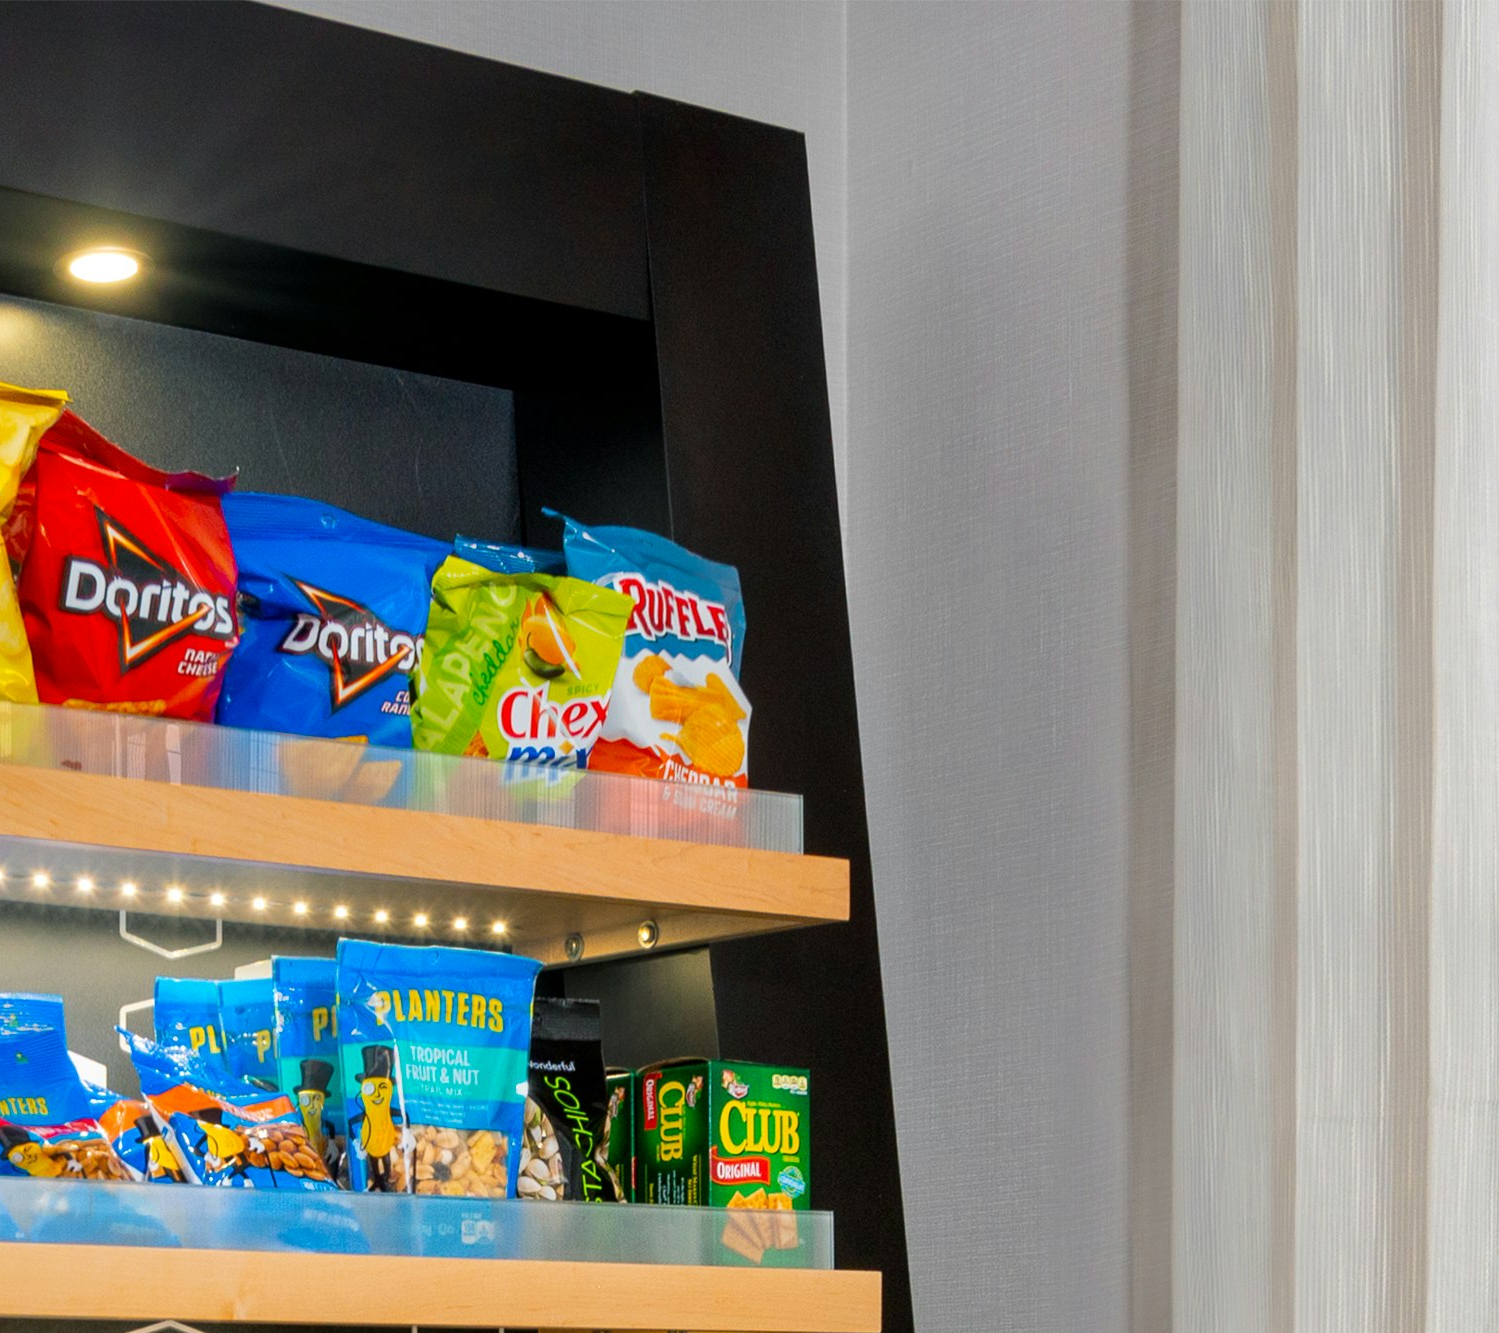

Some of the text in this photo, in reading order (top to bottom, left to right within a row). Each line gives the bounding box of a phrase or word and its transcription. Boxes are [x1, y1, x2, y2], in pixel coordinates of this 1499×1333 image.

[64, 558, 234, 636] Doritos
[566, 683, 601, 697] SPICY
[500, 688, 611, 740] Chex
[374, 989, 504, 1033] PLANTERS
[405, 1063, 480, 1086] FRUIT & NUT
[410, 1045, 471, 1067] TROPICAL
[645, 1078, 655, 1121] ORIGINAL
[657, 1080, 686, 1162] CLUB
[719, 1100, 801, 1155] CLUB
[716, 1161, 762, 1179] ORIGINAL
